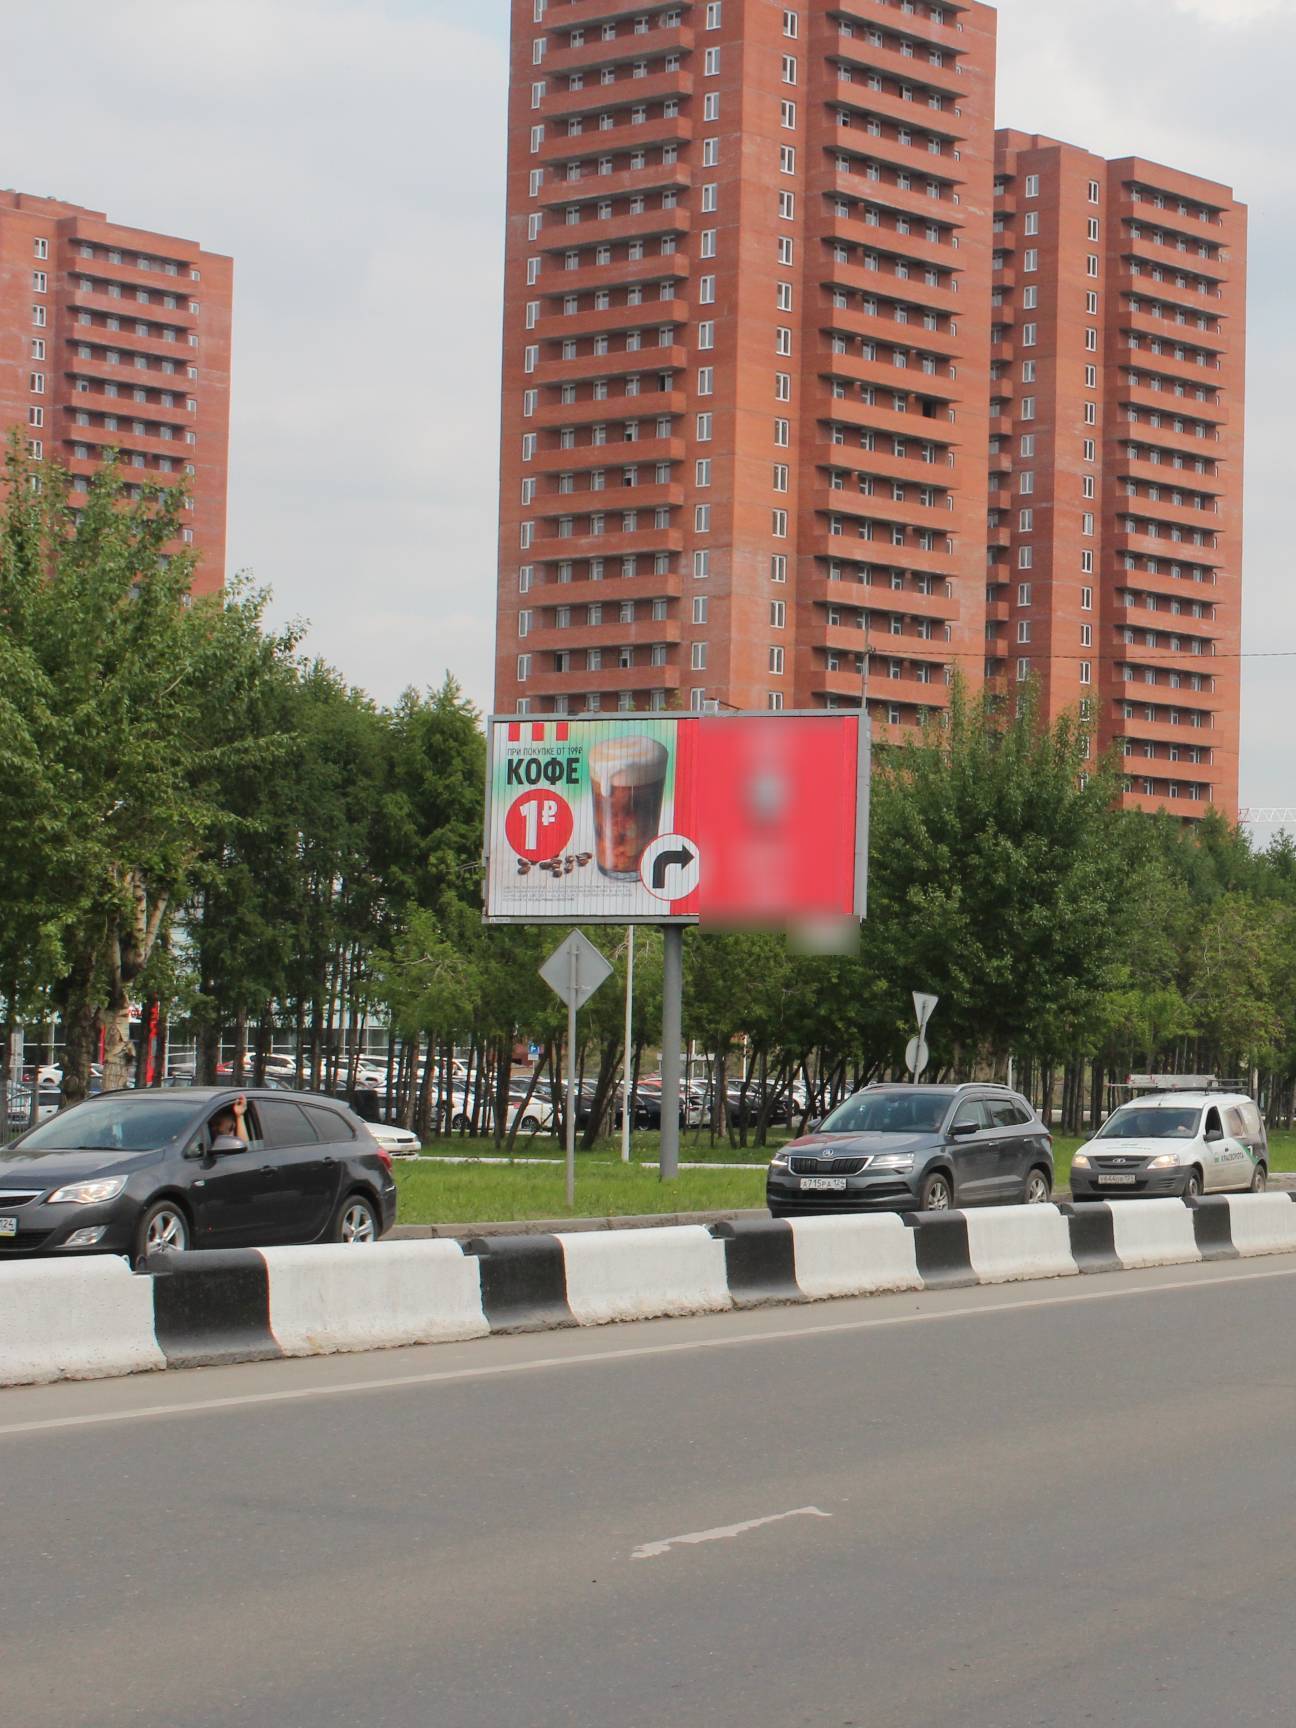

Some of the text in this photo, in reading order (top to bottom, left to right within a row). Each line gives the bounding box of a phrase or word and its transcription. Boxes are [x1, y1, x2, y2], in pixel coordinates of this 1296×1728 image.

[507, 747, 521, 756] ПРИ
[524, 747, 555, 756] ПОКУПКЕ
[556, 747, 565, 756] ОТ
[507, 757, 580, 786] КОФЕ
